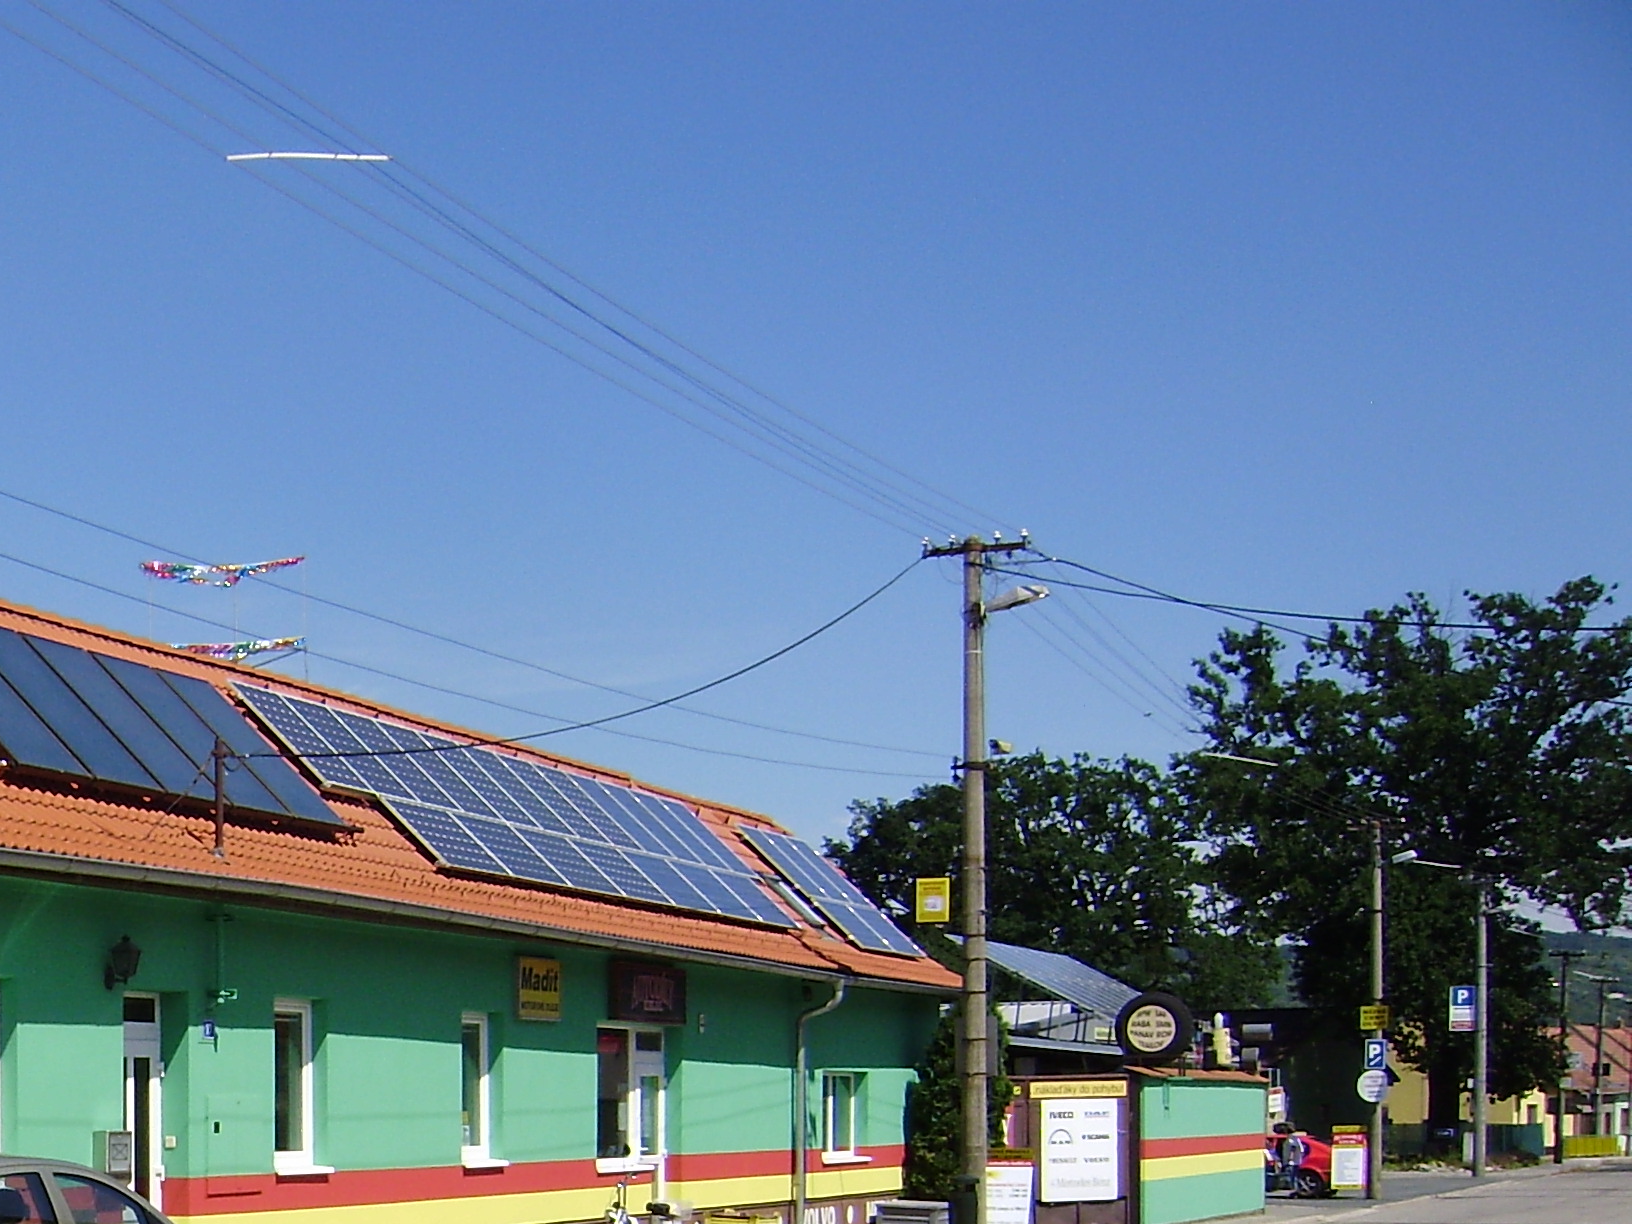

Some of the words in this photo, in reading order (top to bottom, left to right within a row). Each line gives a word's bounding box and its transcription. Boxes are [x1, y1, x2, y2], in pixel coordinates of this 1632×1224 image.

[521, 966, 558, 992] Madit
[1457, 989, 1469, 1004] P
[1368, 1044, 1381, 1059] P
[1049, 1111, 1074, 1119] IVECO
